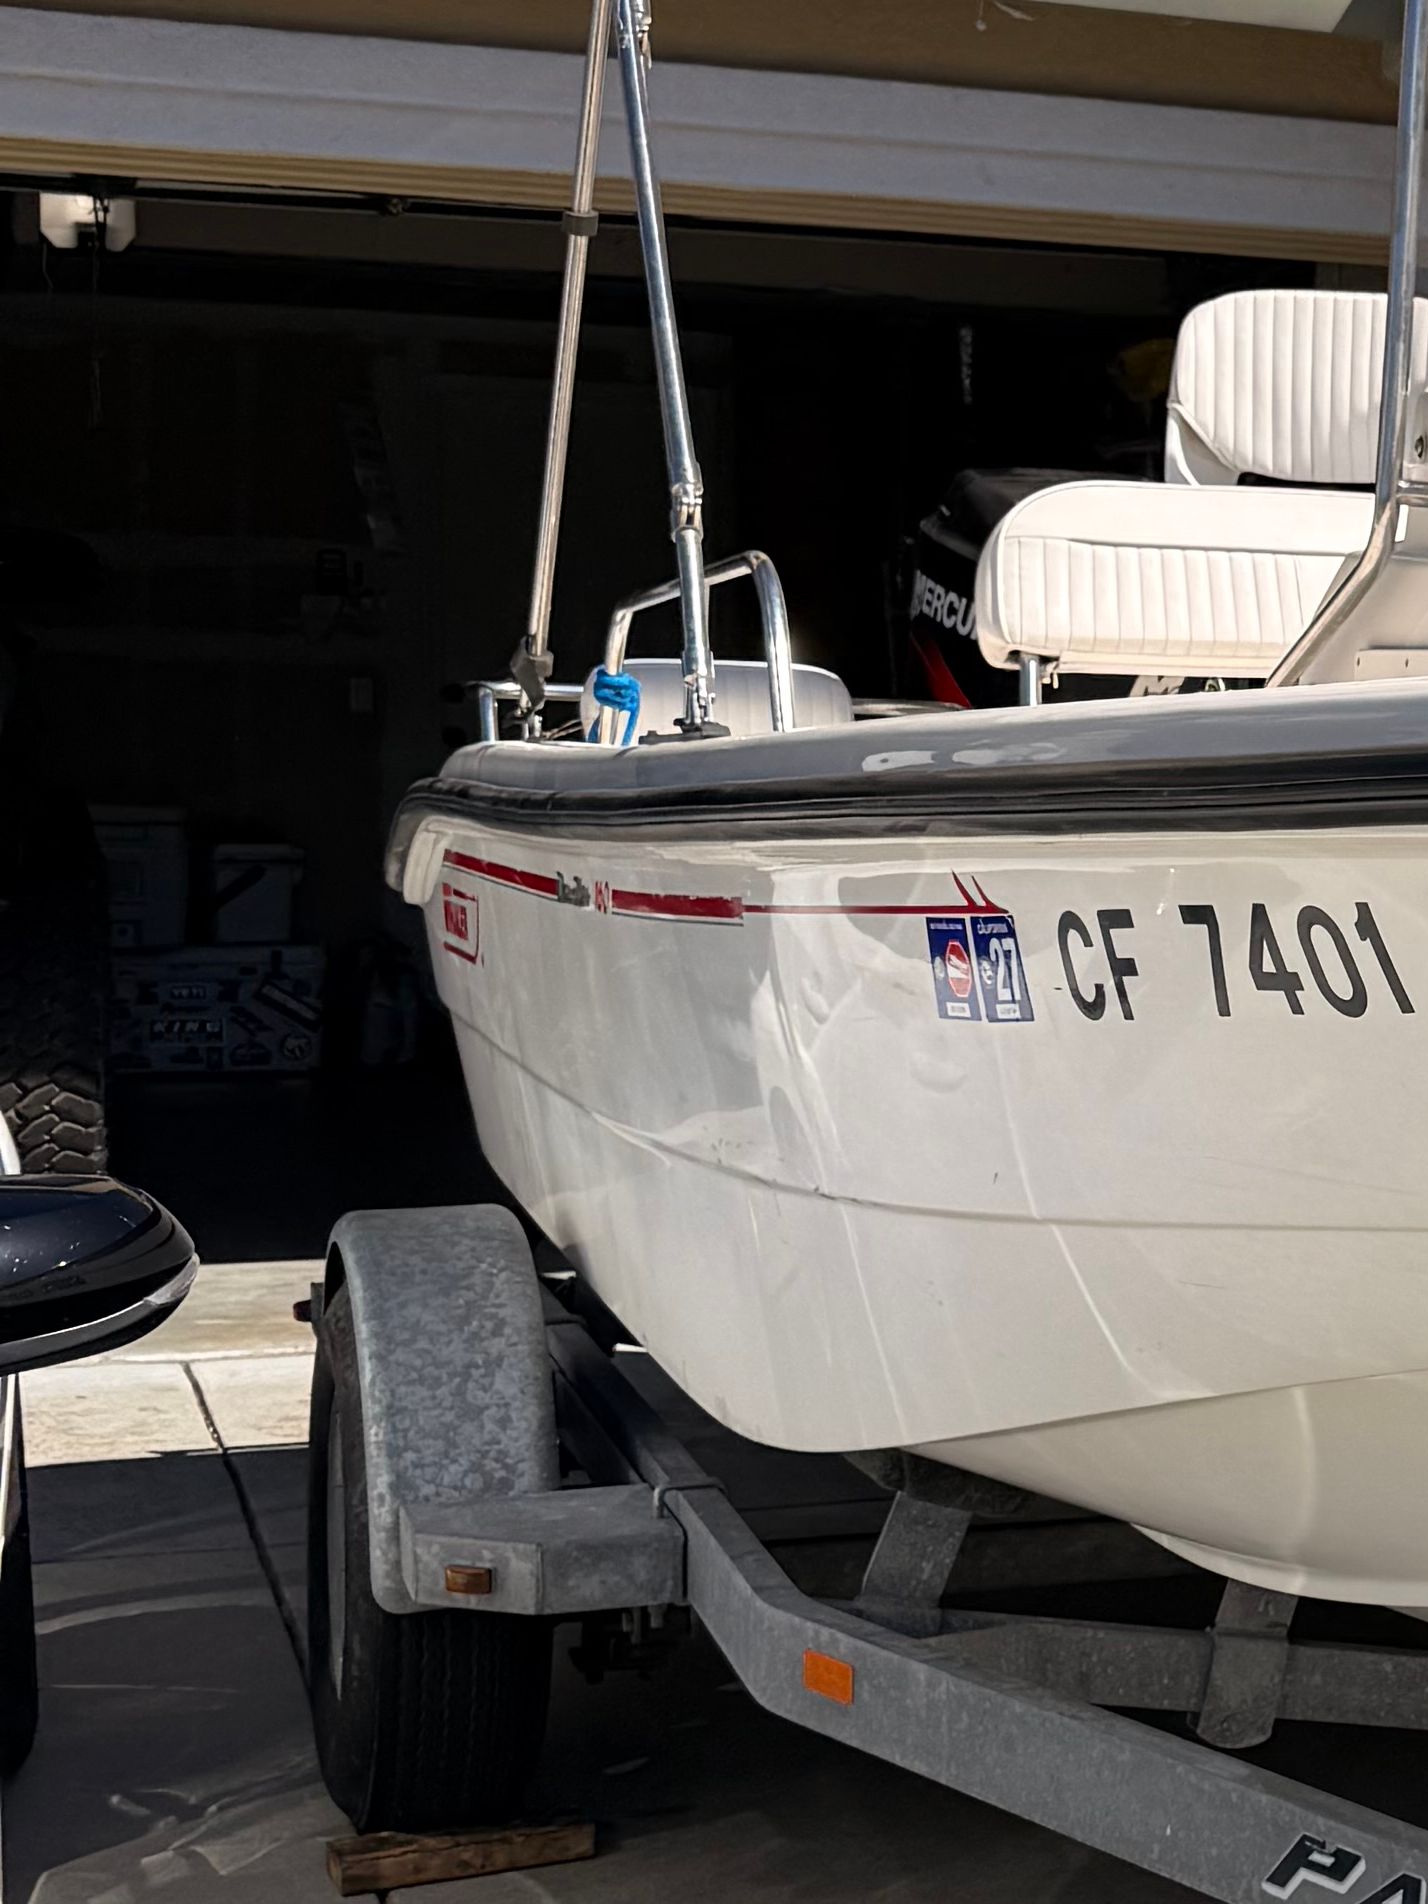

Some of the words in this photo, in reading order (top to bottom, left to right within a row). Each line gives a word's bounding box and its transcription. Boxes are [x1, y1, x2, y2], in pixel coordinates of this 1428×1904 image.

[911, 569, 977, 640] MERCU
[989, 937, 1022, 1001] 27
[1058, 909, 1140, 1021] CF
[1178, 901, 1416, 1018] 7401
